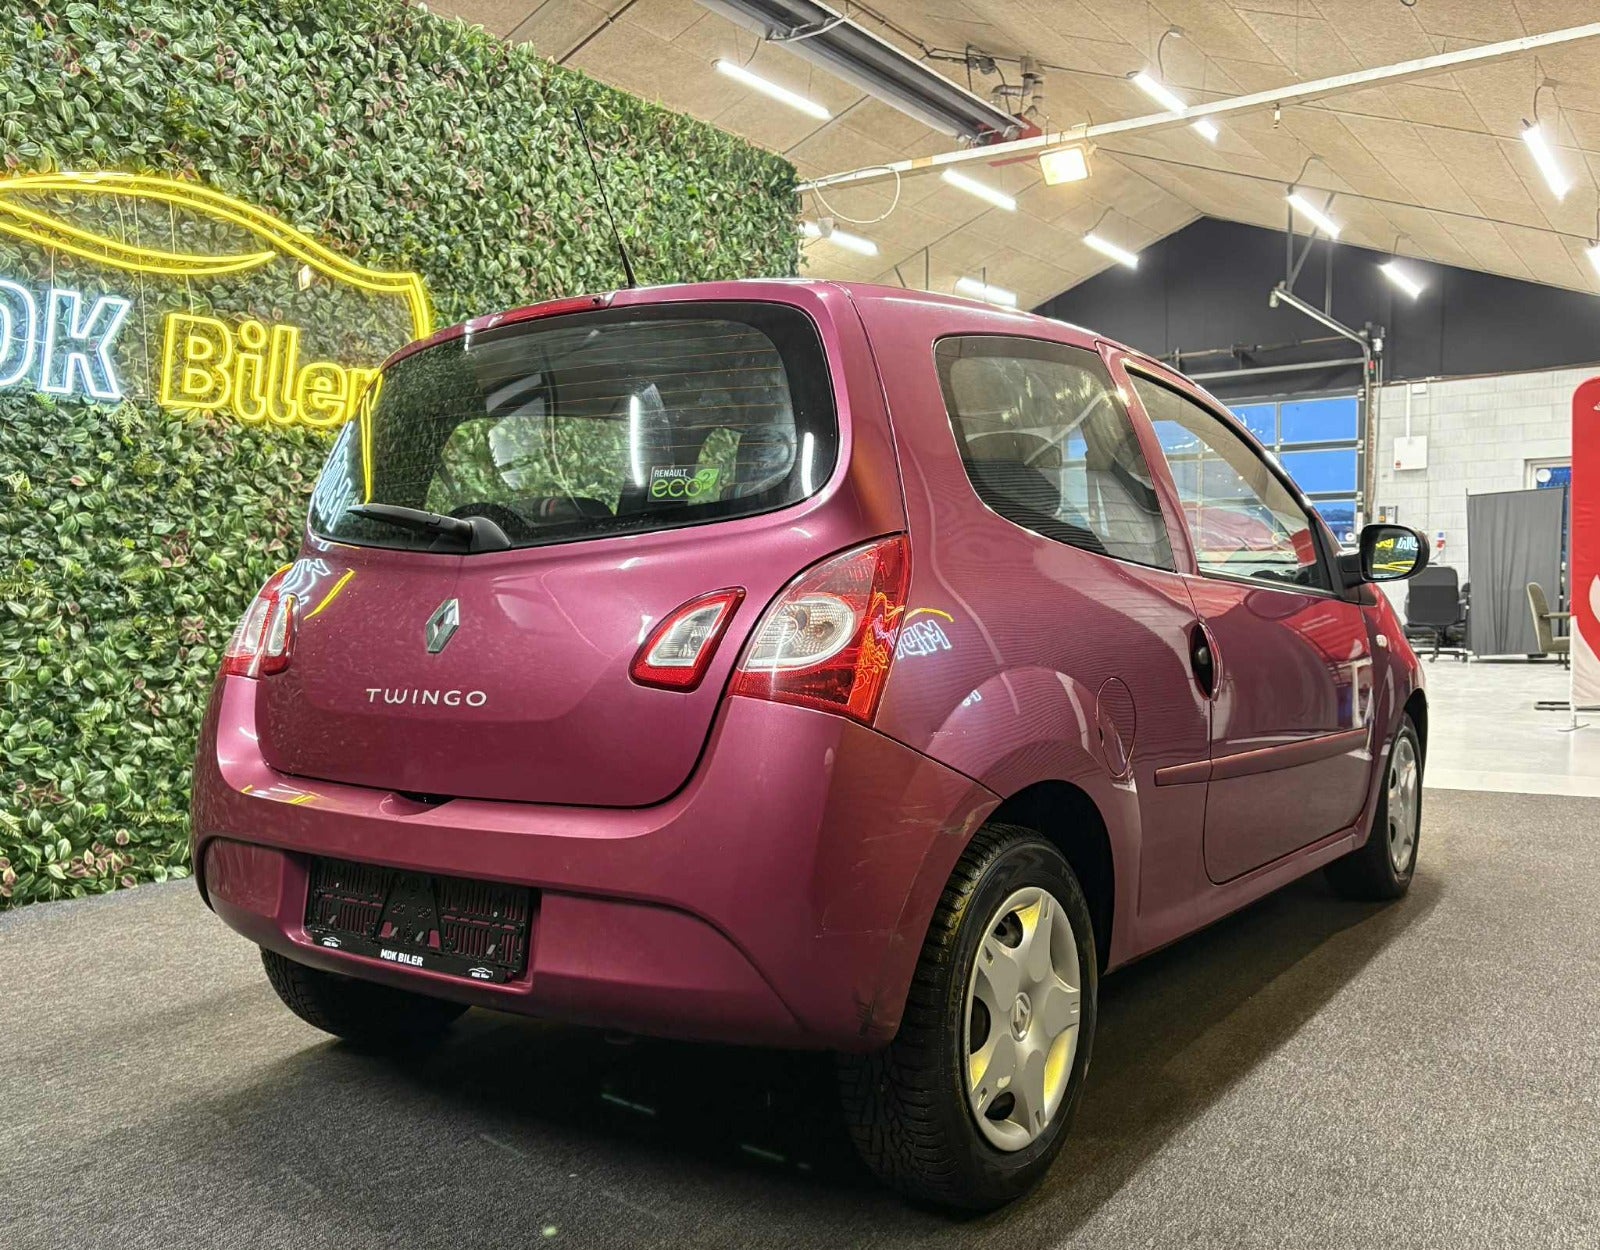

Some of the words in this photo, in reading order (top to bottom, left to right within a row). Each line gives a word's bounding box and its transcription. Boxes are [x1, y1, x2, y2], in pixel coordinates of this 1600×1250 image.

[161, 312, 381, 427] Biler
[654, 468, 688, 478] RENAULT
[366, 688, 487, 706] TWINGO
[380, 948, 398, 961] MDK
[397, 952, 424, 967] BILER
